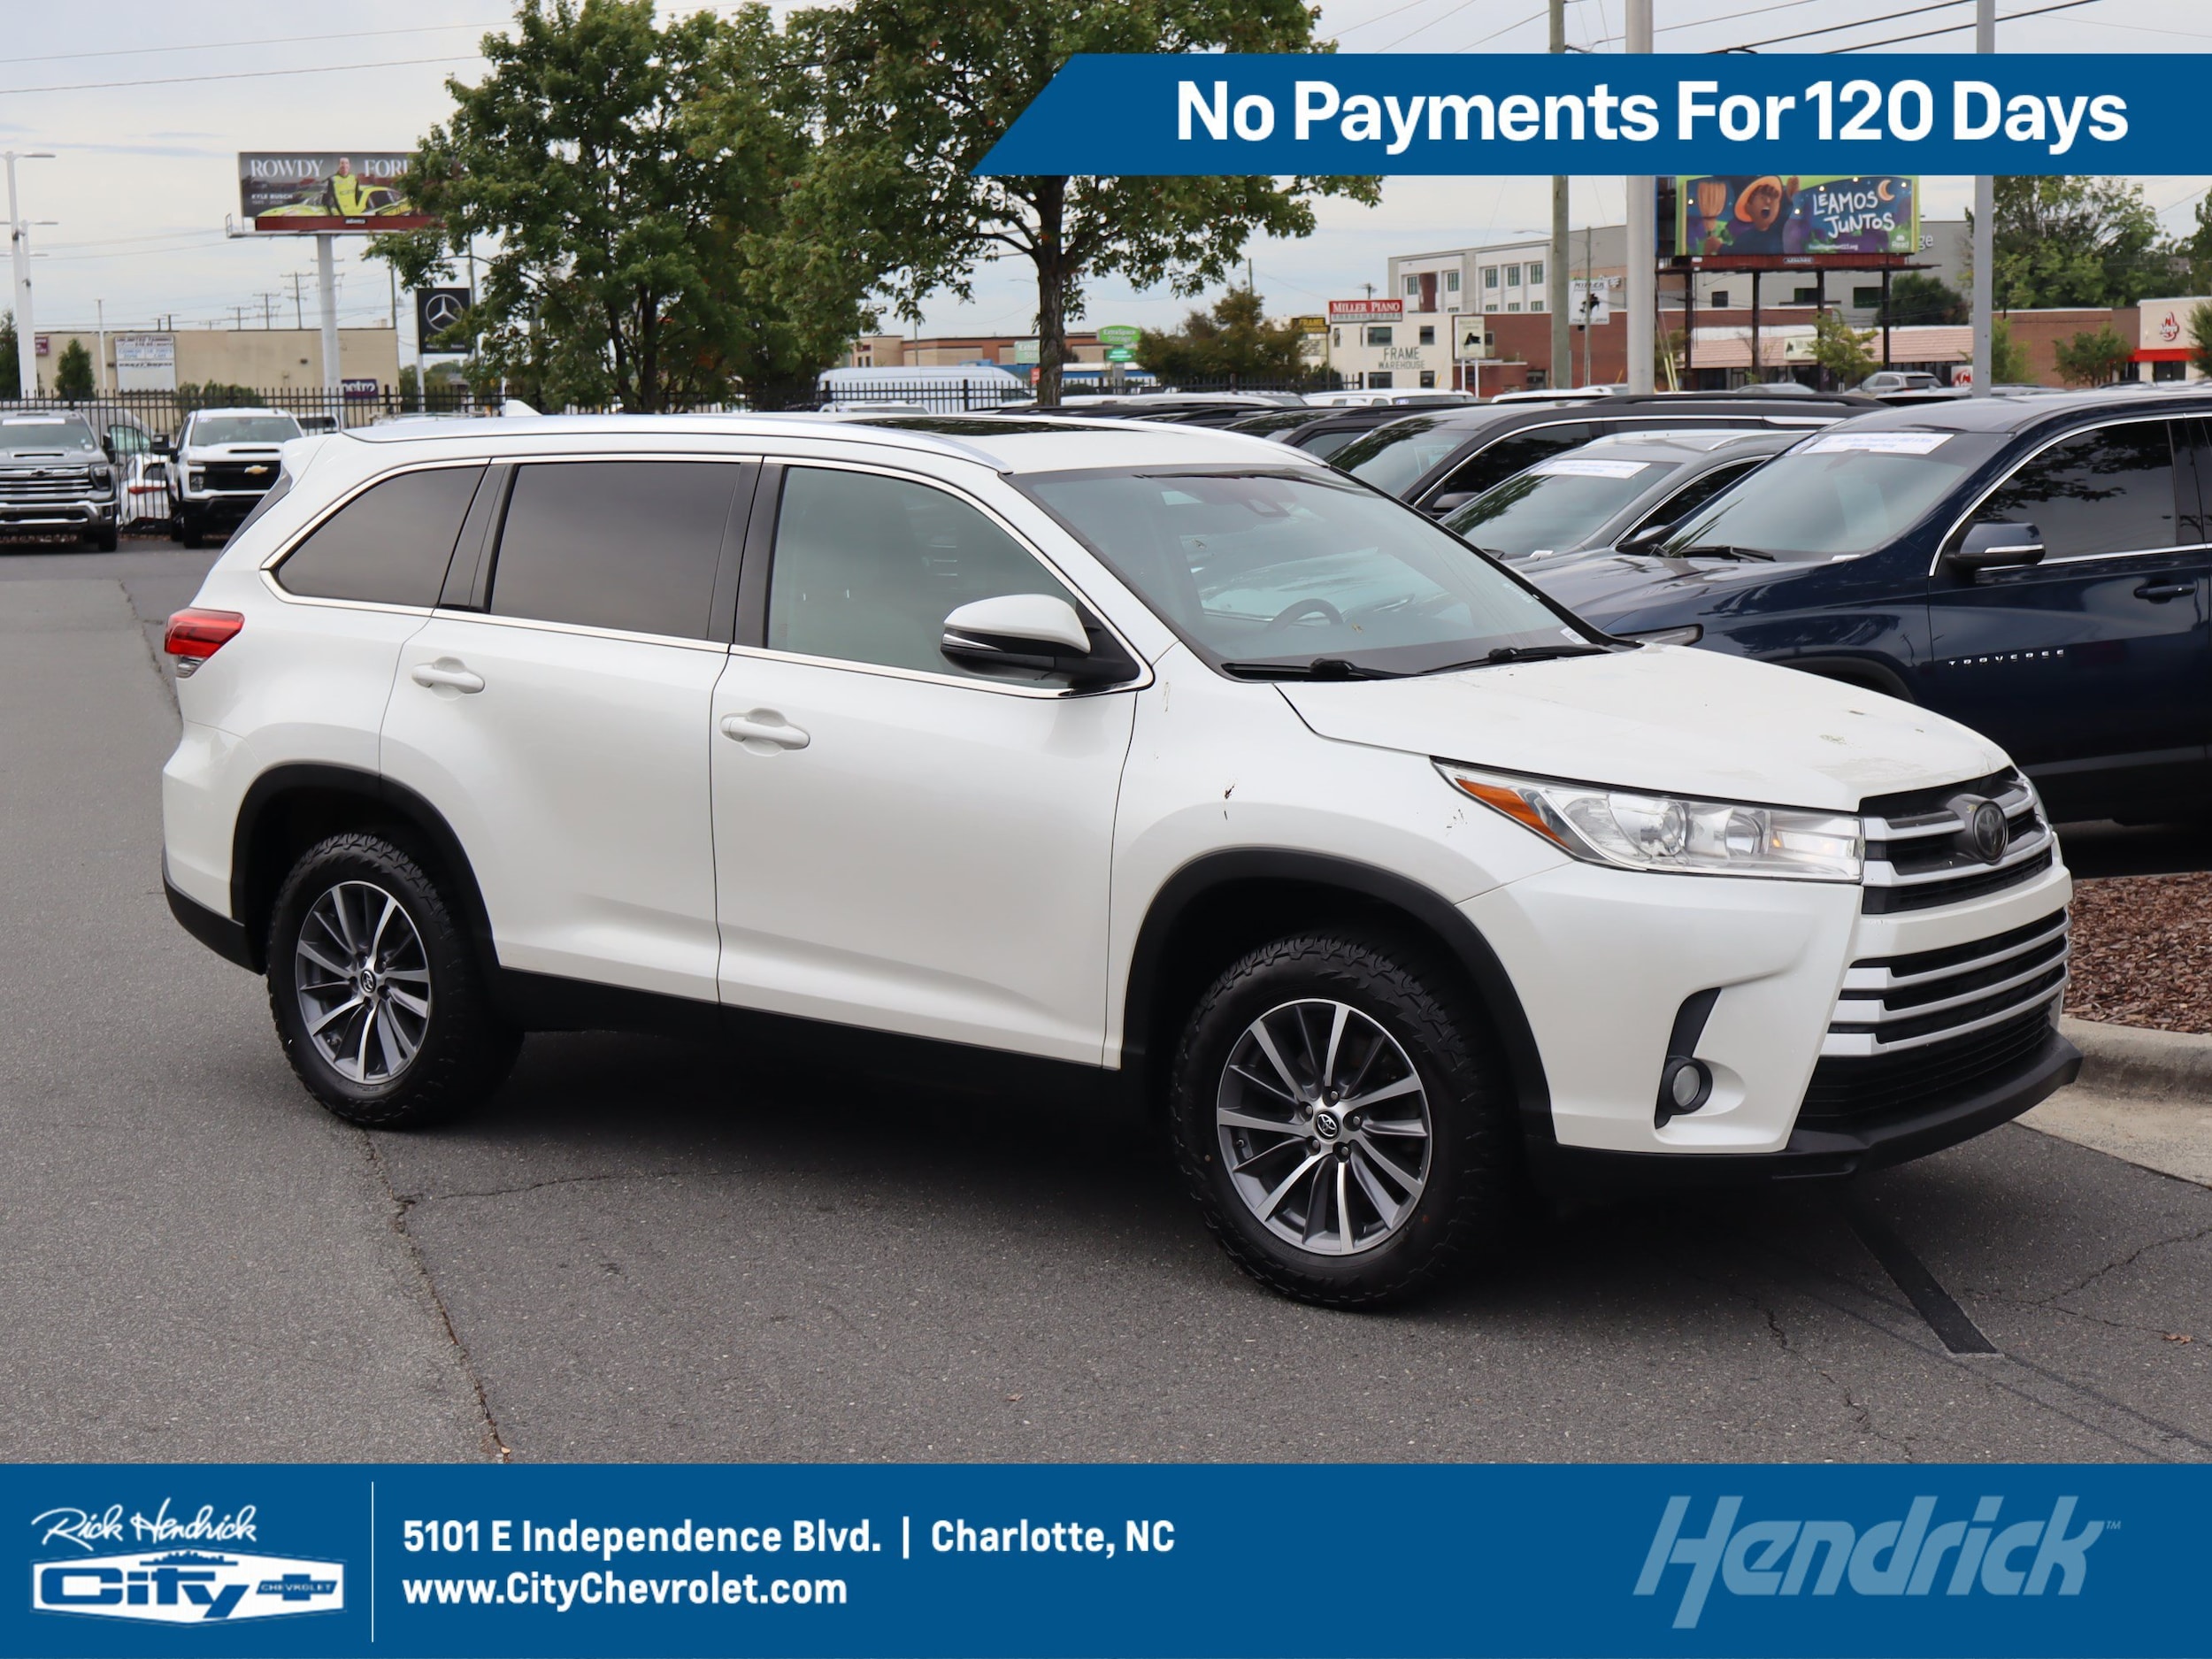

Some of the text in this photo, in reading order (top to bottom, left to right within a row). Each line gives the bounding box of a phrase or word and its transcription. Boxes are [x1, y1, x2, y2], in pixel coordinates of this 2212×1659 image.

[250, 158, 324, 178] ROWDY
[1813, 190, 1878, 216] LEAMOS
[1333, 302, 1401, 313] MILLER PIANO
[1383, 347, 1420, 360] FRAME
[1378, 360, 1425, 370] WAREHOUSE
[1948, 649, 2065, 667] TRAVERSE
